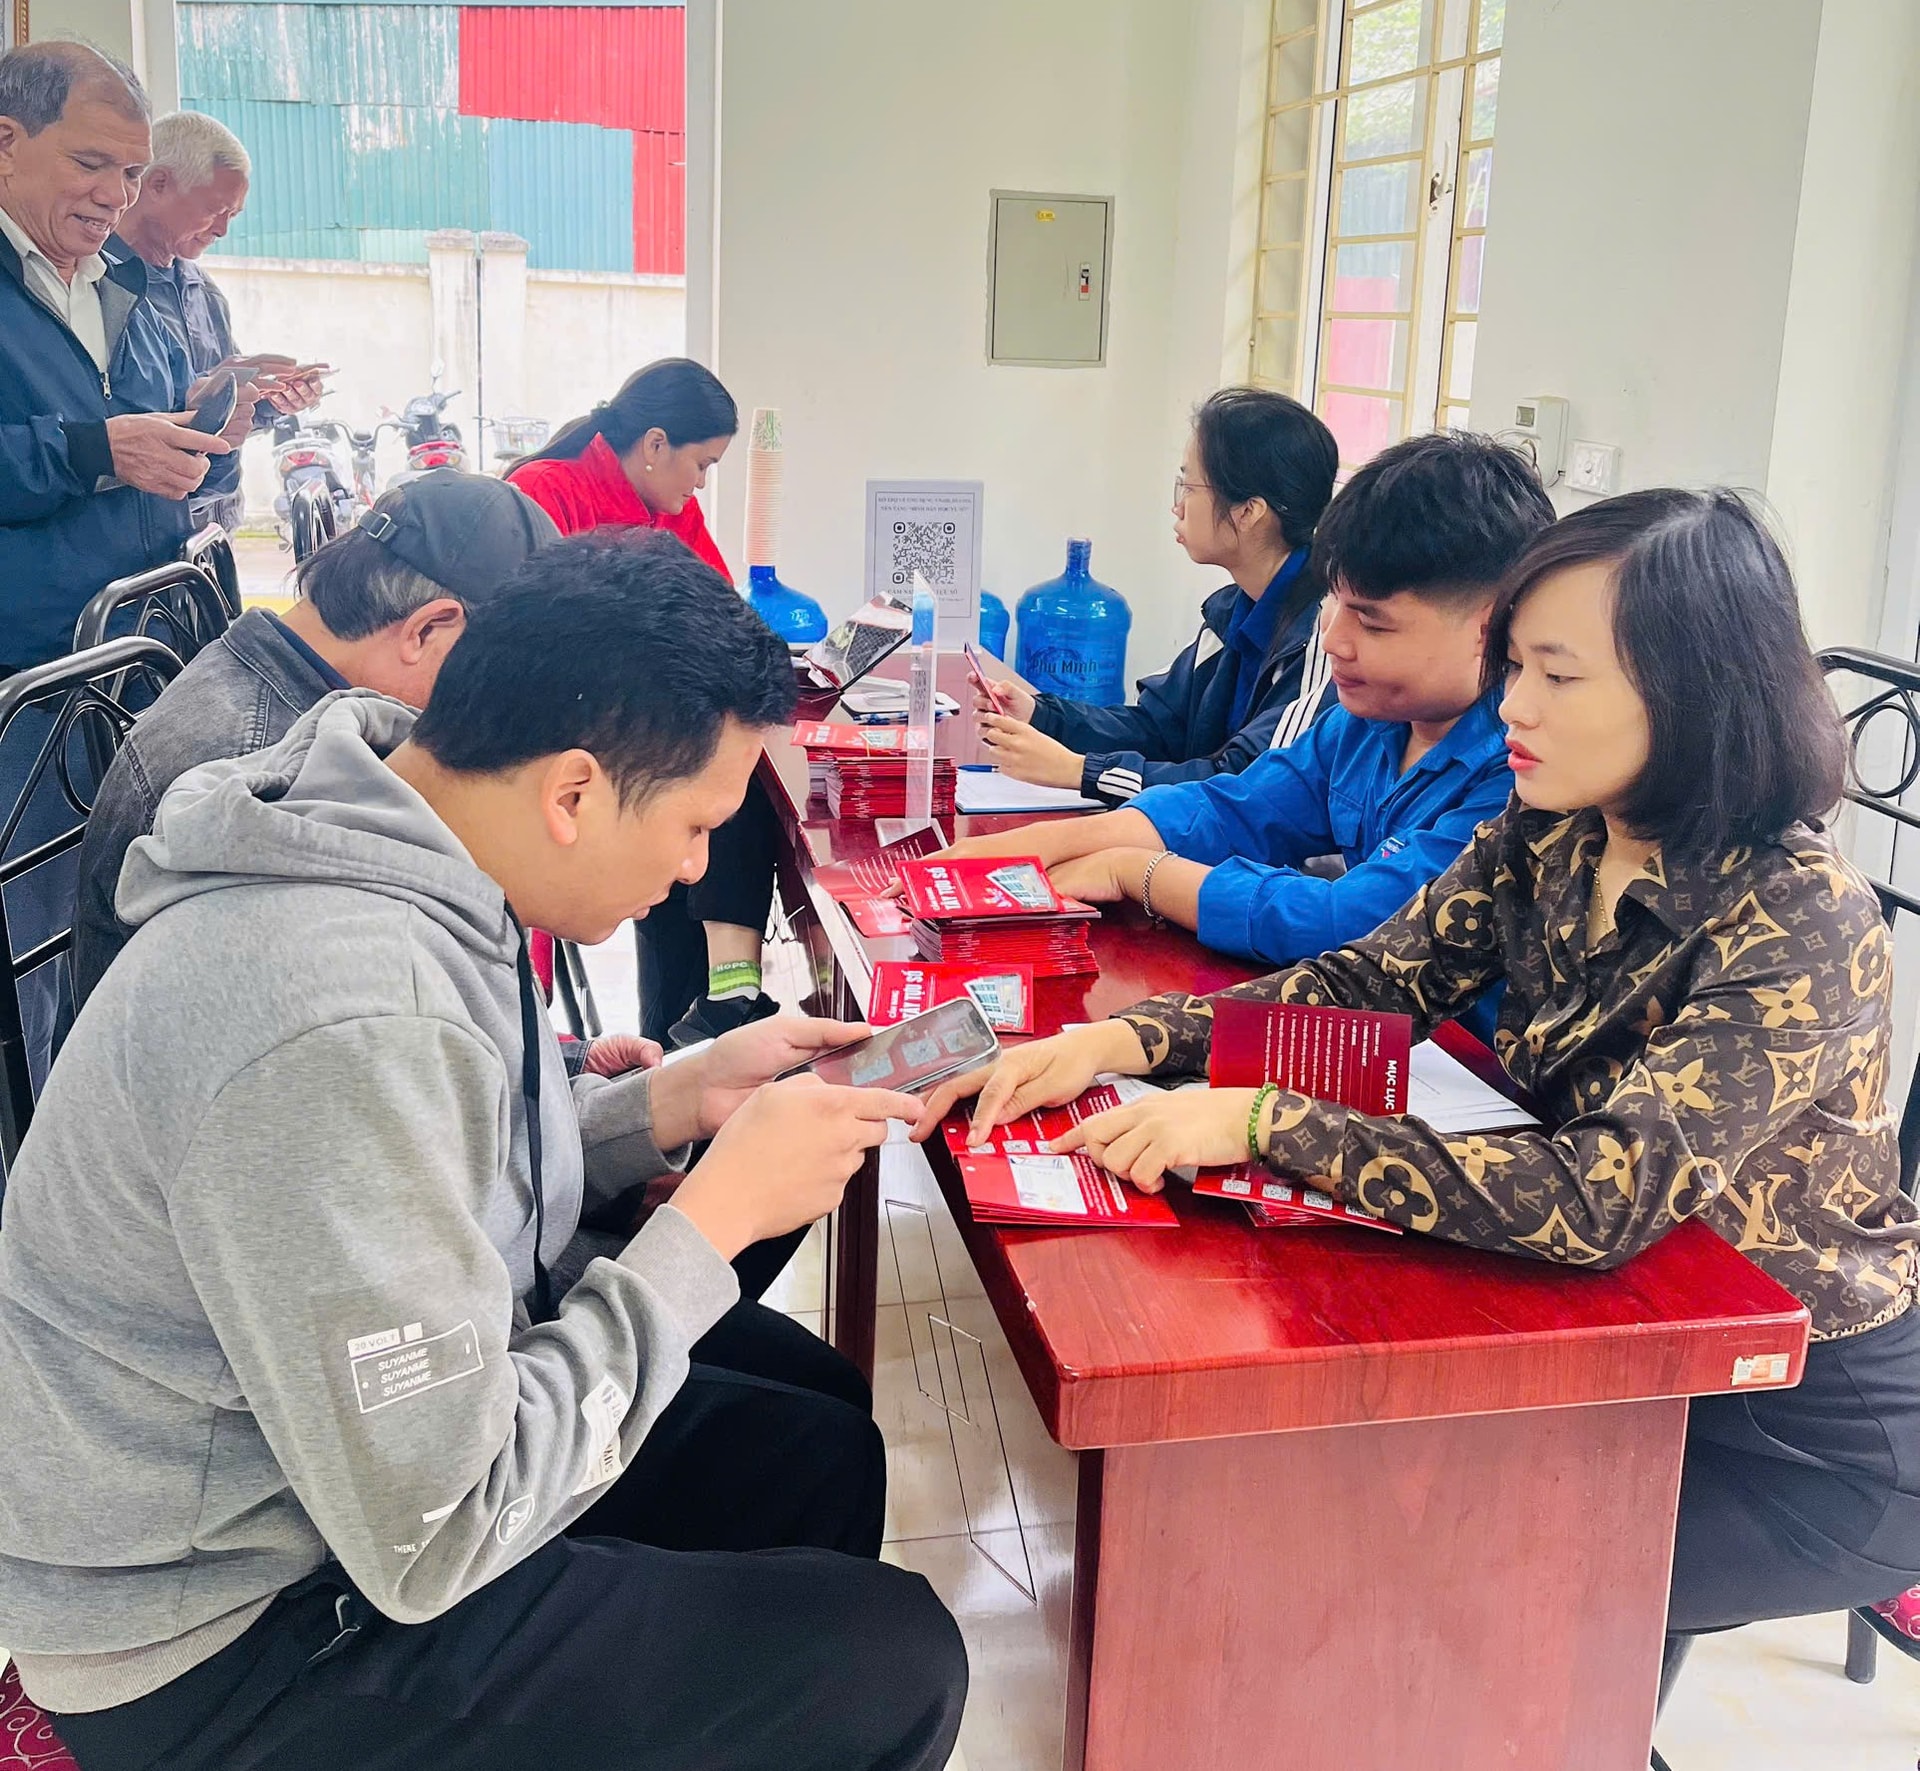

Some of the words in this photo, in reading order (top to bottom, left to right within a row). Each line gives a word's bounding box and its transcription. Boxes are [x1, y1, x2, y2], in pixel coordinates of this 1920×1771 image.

[1385, 1059, 1397, 1086] MỤC
[1383, 1088, 1396, 1110] LỤC
[393, 1543, 417, 1554] THERE
